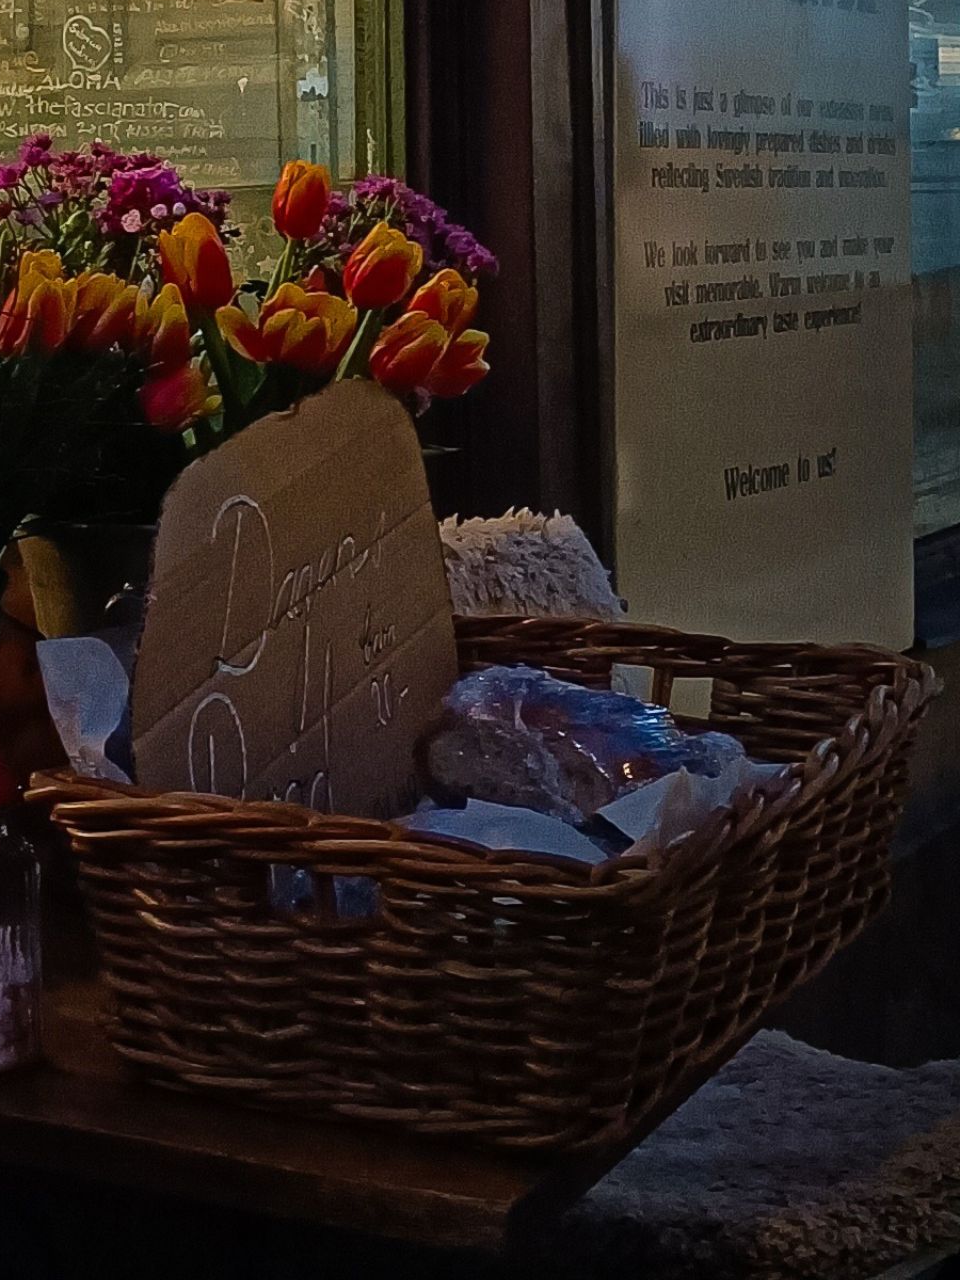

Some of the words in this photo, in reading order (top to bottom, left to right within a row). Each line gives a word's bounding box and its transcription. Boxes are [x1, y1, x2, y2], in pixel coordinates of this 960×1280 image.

[641, 81, 670, 111] This
[676, 88, 688, 111] is
[692, 86, 715, 117] just
[720, 92, 728, 113] a
[733, 89, 776, 121] glimpse
[781, 92, 792, 117] of
[639, 120, 670, 149] filled
[676, 124, 702, 150] with
[707, 124, 752, 157] lovingly
[756, 128, 805, 158] prepared
[846, 130, 864, 155] and
[651, 161, 710, 194] reflecting
[715, 163, 764, 188] Swedish
[768, 163, 812, 188] tradition
[816, 164, 834, 188] and
[643, 240, 667, 269] We
[672, 239, 698, 267] look
[704, 238, 751, 265] forward
[755, 236, 767, 262] to
[772, 240, 791, 261] see
[796, 238, 816, 264] you
[819, 235, 837, 259] and
[663, 280, 690, 308] visit
[695, 274, 764, 305] memorable.
[769, 271, 802, 298] Warm
[806, 270, 850, 295] welcome
[689, 312, 769, 344] extraordinary
[773, 309, 800, 334] taste
[804, 301, 863, 335] experience!
[724, 461, 791, 501] Welcome
[796, 455, 811, 484] to
[817, 446, 838, 477] us!
